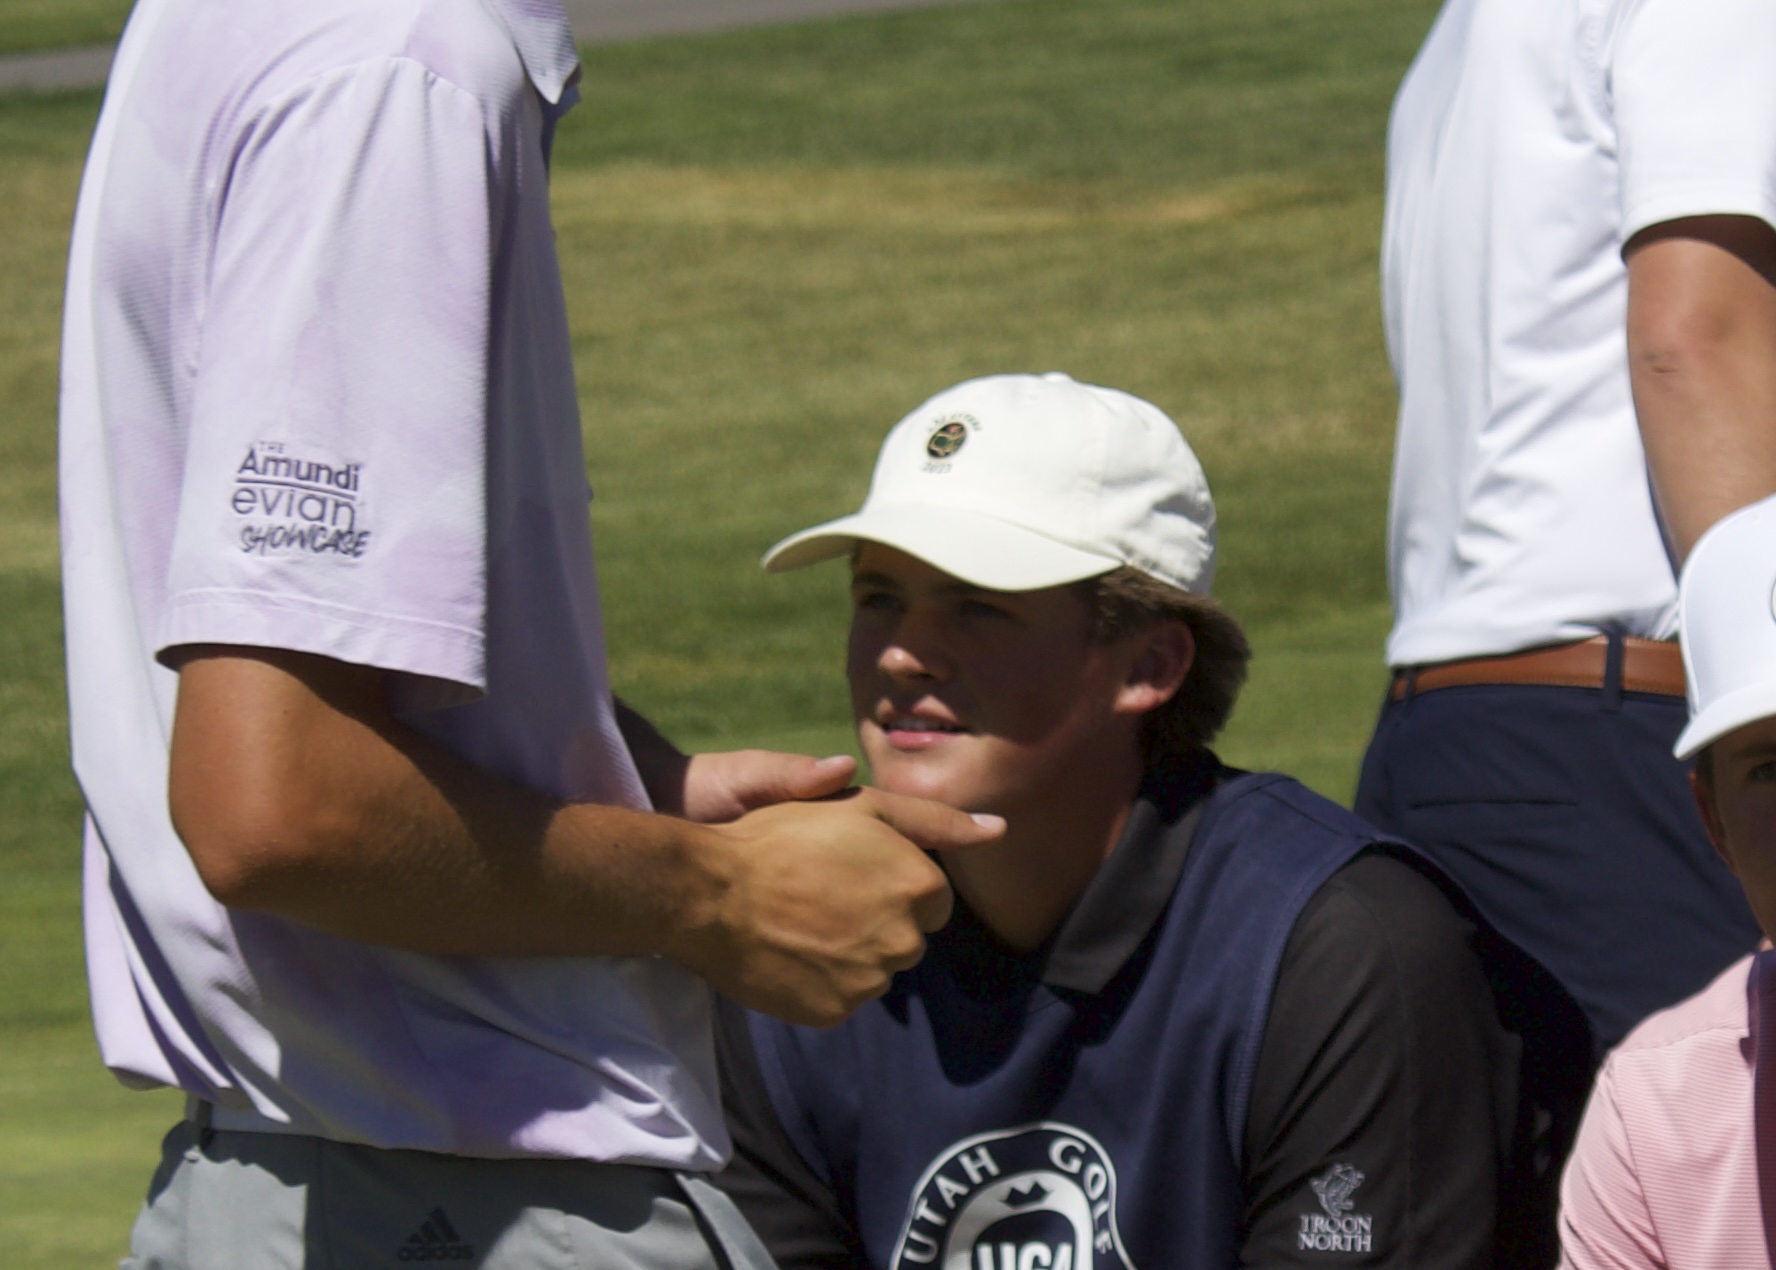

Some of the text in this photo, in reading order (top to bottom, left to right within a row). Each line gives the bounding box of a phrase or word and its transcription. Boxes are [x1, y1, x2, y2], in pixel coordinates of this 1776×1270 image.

[238, 447, 360, 491] Amundi
[231, 488, 355, 531] evian
[241, 522, 372, 558] SHOWCASE
[903, 1136, 1113, 1264] UTAH GOLF
[1298, 1232, 1372, 1252] NORTH
[1300, 1214, 1372, 1234] TROON
